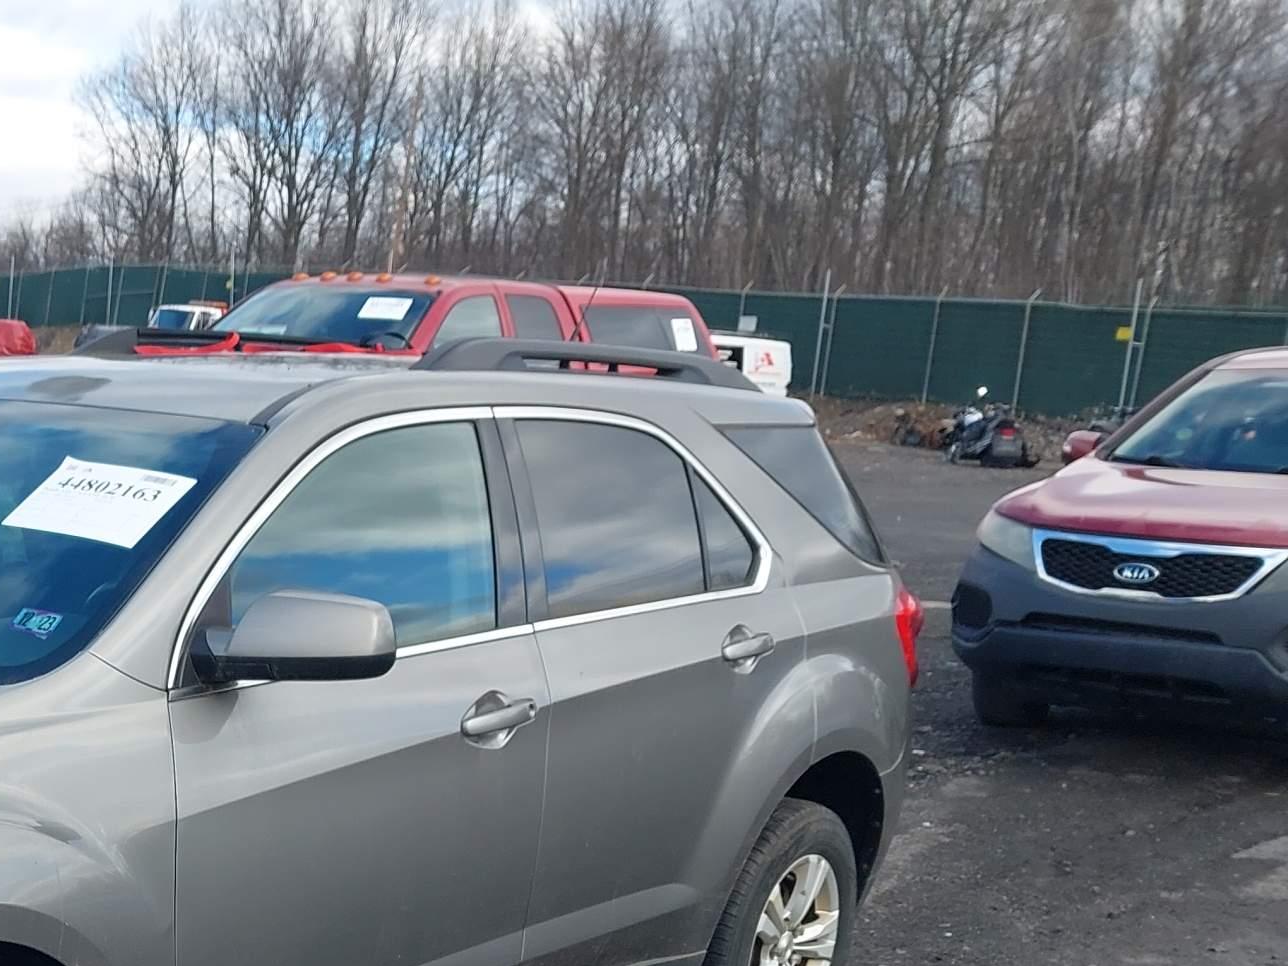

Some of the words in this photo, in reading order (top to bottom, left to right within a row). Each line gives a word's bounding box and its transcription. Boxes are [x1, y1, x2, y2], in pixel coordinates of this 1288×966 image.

[58, 475, 163, 503] 44802163
[1121, 566, 1150, 581] KIA
[37, 615, 57, 632] 23
